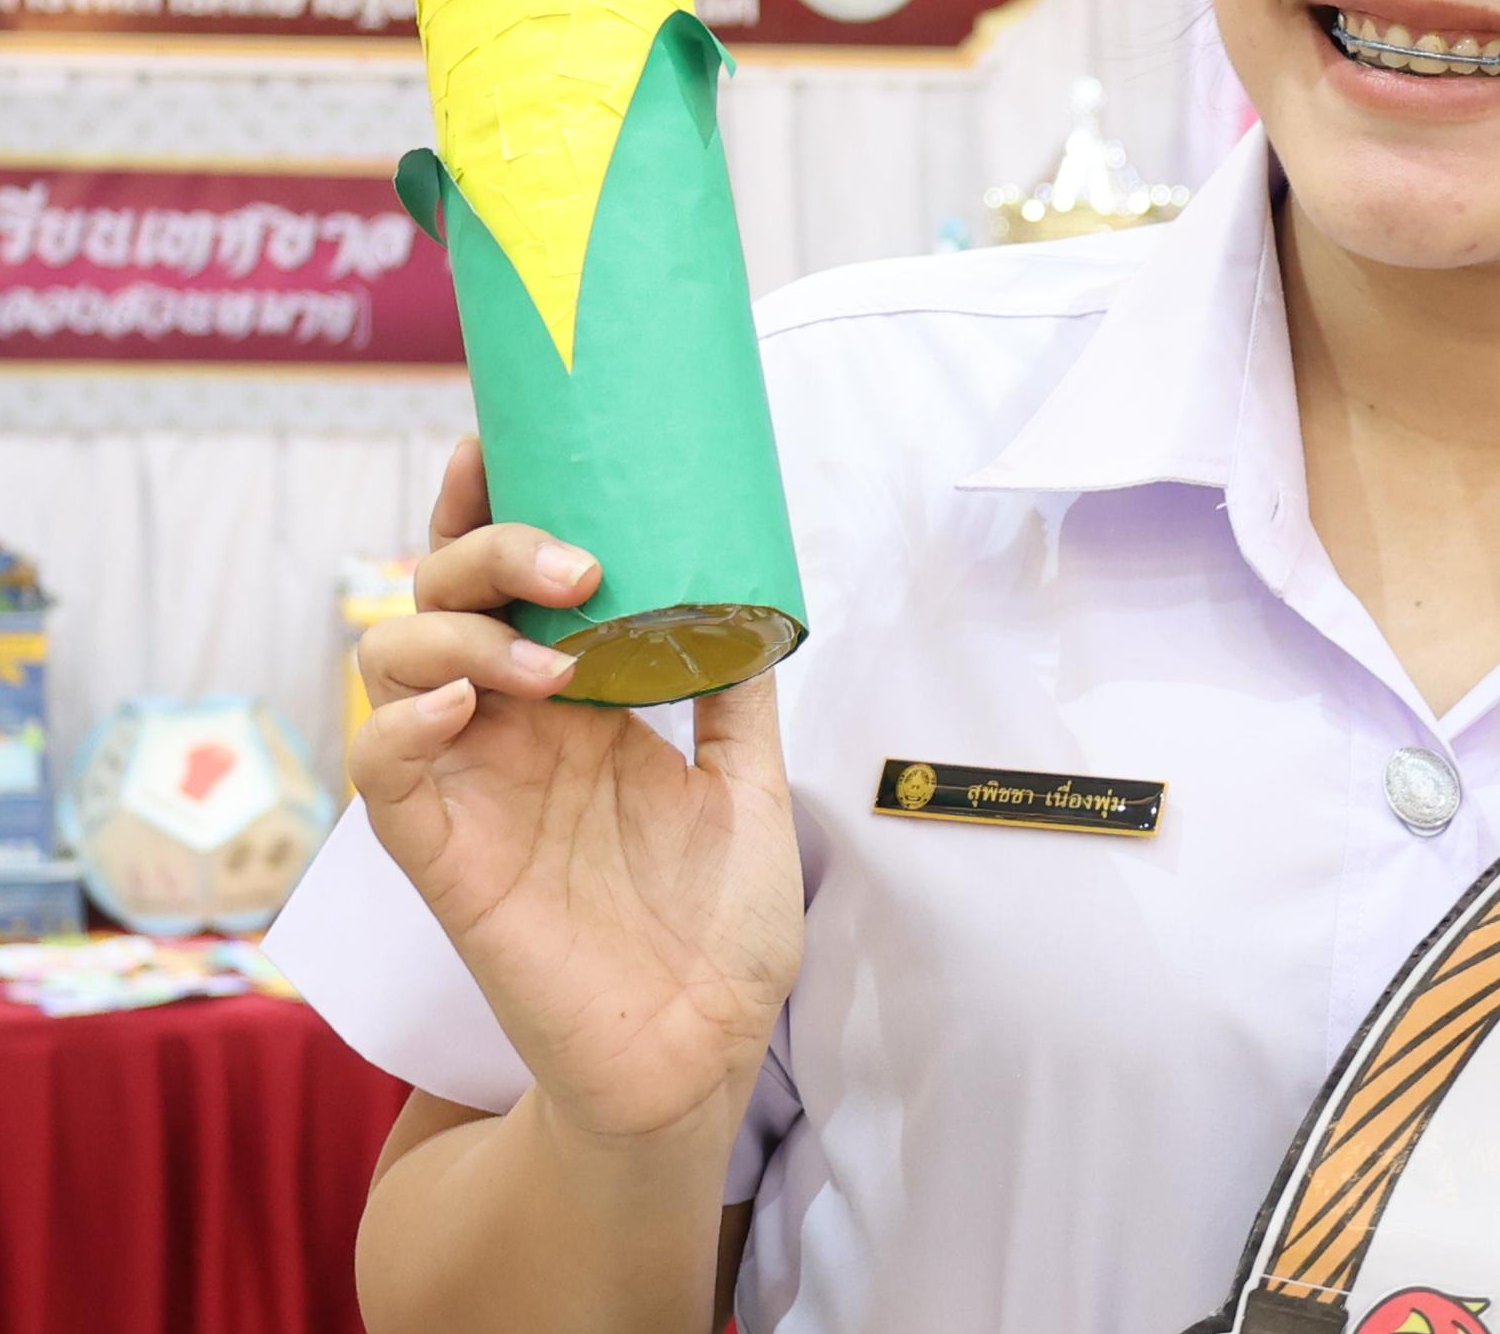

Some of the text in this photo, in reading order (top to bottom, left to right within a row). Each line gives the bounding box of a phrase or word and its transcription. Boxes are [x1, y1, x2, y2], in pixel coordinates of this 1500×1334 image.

[966, 779, 1128, 820] สุพิชชา เนื่องพุ่ม
